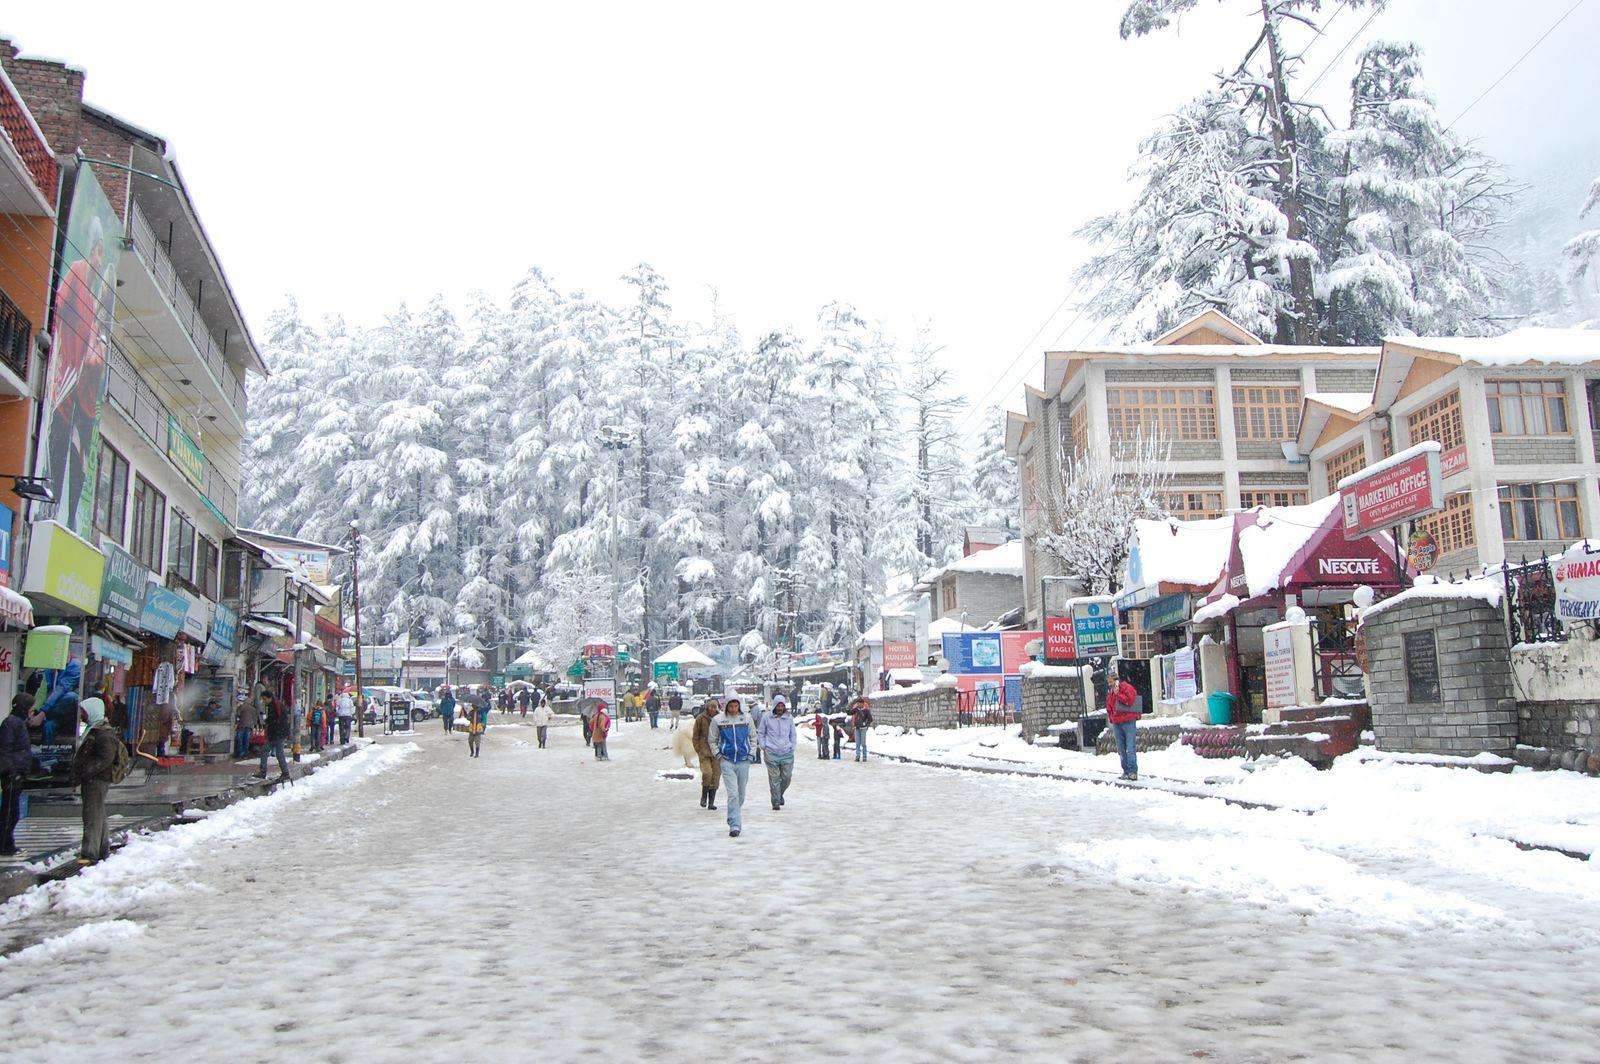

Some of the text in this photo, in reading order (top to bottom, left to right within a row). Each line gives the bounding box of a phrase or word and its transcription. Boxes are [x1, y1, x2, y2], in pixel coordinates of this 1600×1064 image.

[1359, 471, 1427, 509] MARKETING OFFICE
[1418, 544, 1436, 553] Apple
[1319, 558, 1379, 574] NESCAFÉ
[1092, 633, 1104, 643] BANK
